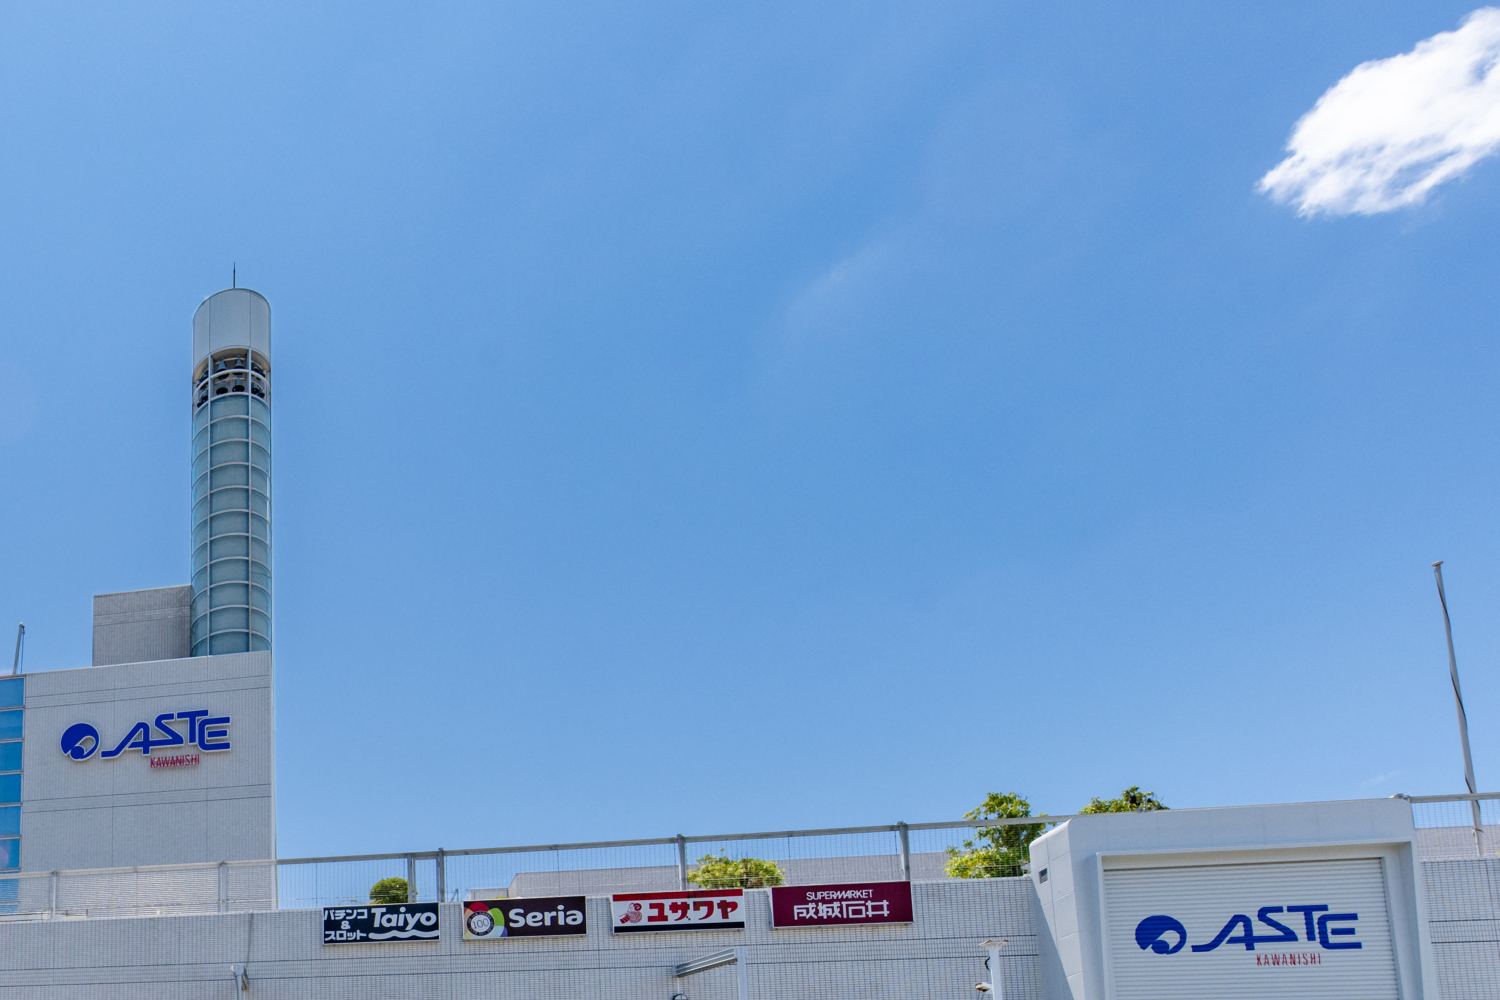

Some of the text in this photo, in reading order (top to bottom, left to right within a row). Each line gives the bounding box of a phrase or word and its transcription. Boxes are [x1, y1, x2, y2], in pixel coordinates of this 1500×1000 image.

[101, 709, 231, 757] ASTE
[150, 754, 200, 769] KAWANISHI
[806, 889, 873, 901] SUPERMARKET
[324, 909, 368, 920] パチンコ
[508, 905, 584, 928] Seria
[647, 900, 739, 922] ユザワヤ
[794, 900, 890, 920] 成城石井
[340, 921, 350, 930] &
[371, 907, 438, 931] Taiyo
[472, 918, 490, 929] 100
[1191, 904, 1363, 951] ASTE
[324, 930, 367, 941] スロット
[1256, 953, 1322, 966] KAWANISHI
